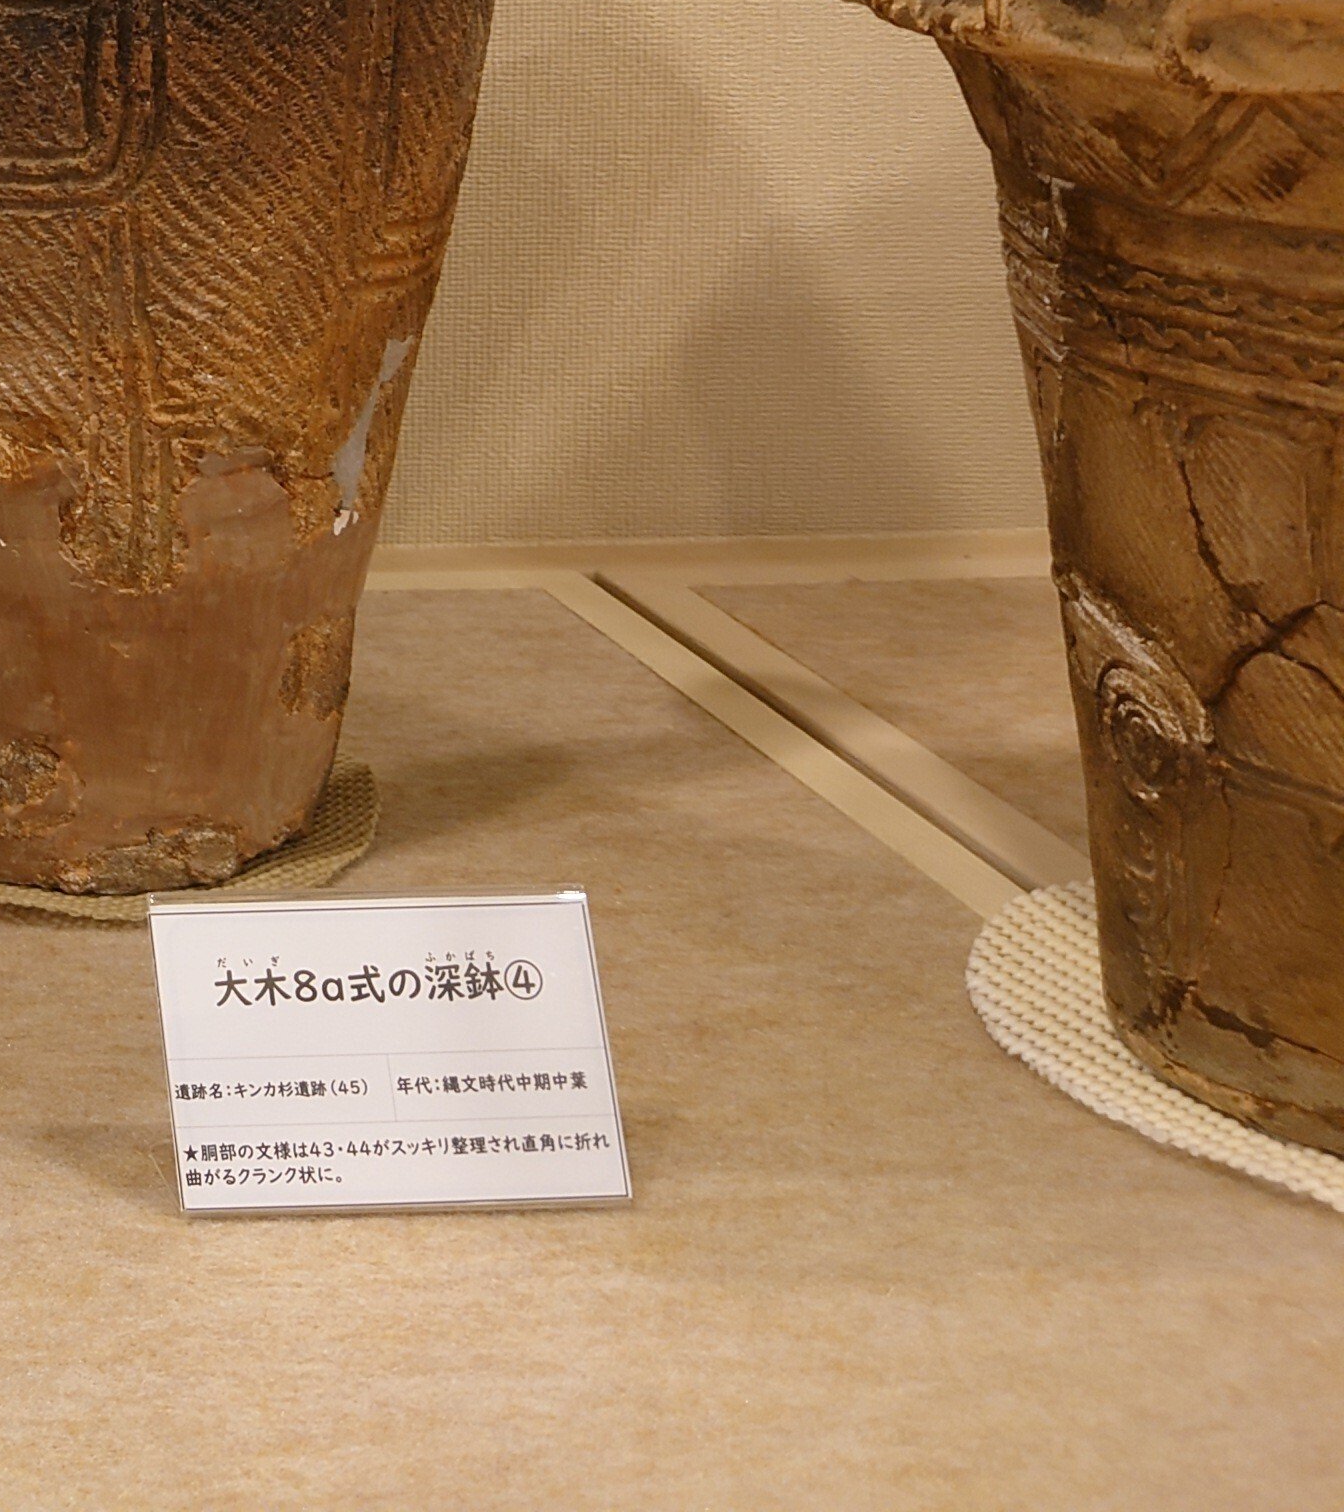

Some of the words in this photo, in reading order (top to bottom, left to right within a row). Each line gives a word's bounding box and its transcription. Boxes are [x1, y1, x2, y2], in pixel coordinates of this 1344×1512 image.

[214, 959, 544, 1007] 大木8a式の深鉢④
[185, 1165, 344, 1187] 曲がるクランク状に。
